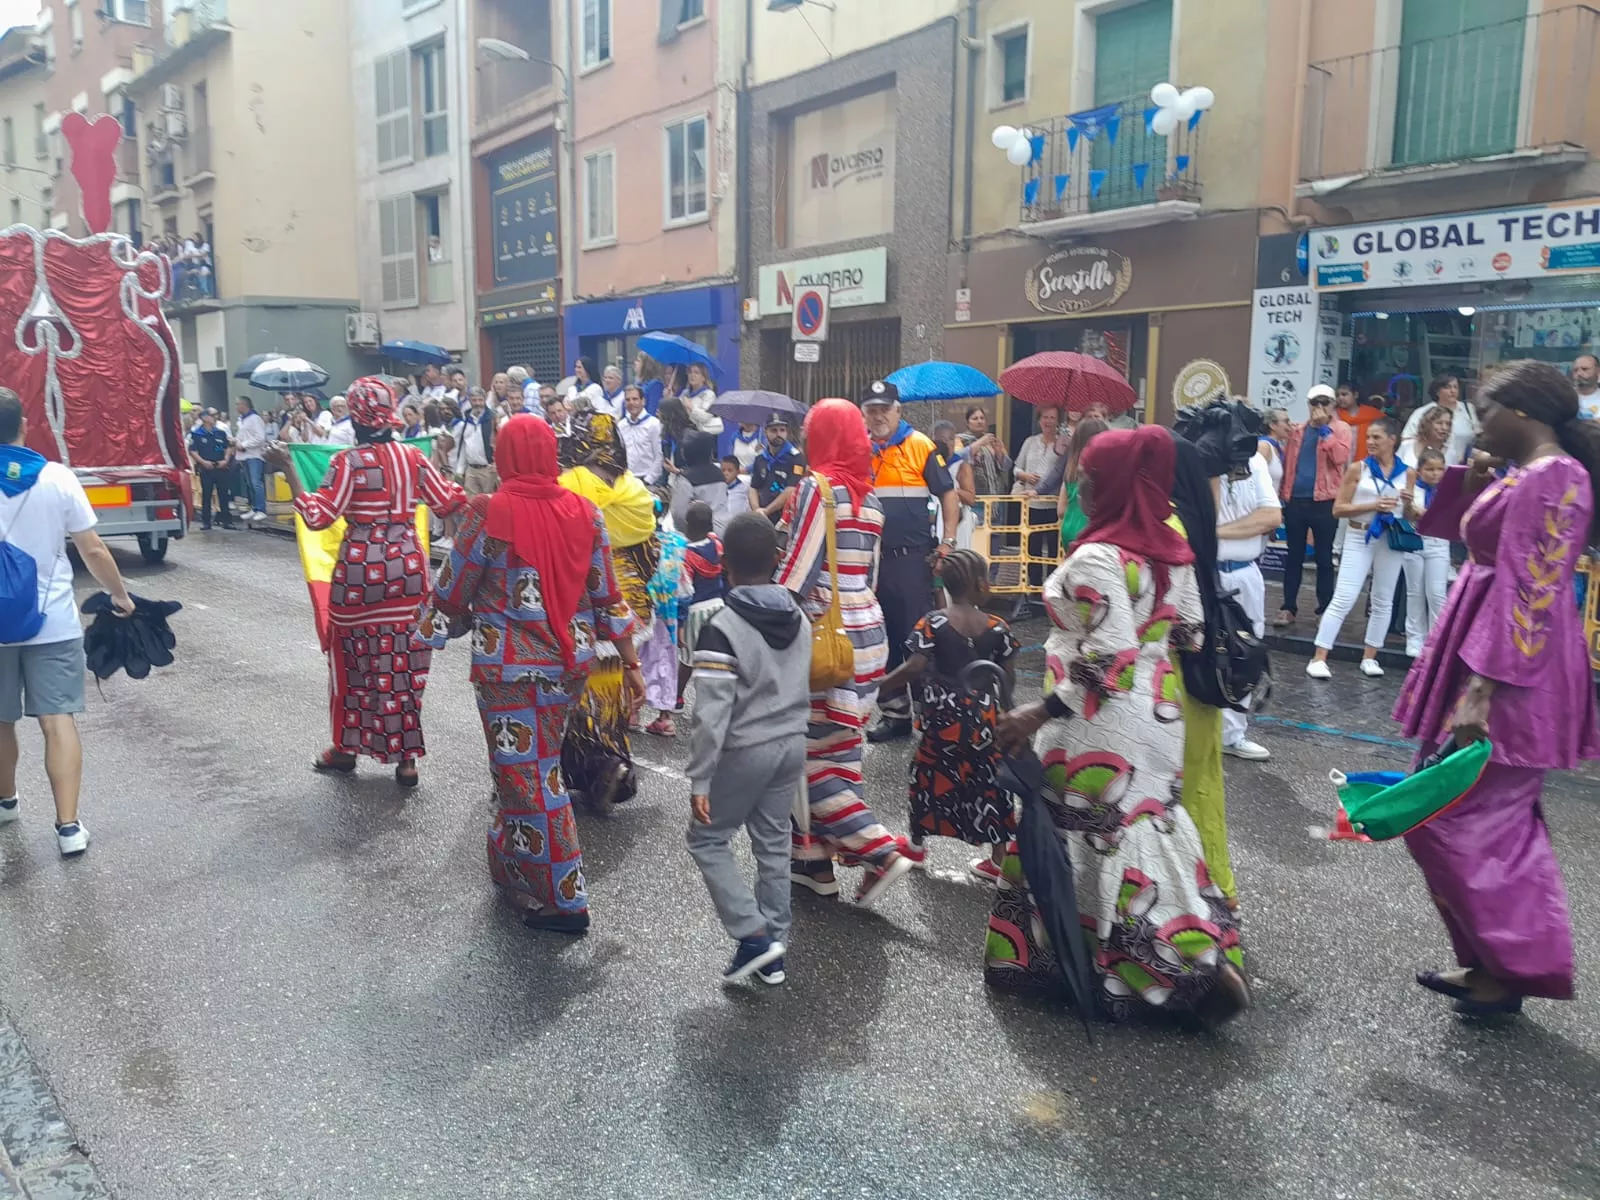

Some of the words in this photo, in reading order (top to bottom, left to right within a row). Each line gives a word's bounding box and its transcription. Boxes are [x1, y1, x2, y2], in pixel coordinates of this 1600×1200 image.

[1352, 222, 1485, 256] GLOBAL
[1497, 208, 1600, 242] TECH
[1280, 267, 1291, 283] 6
[1259, 292, 1313, 308] GLOBAL
[1266, 310, 1302, 324] TECH
